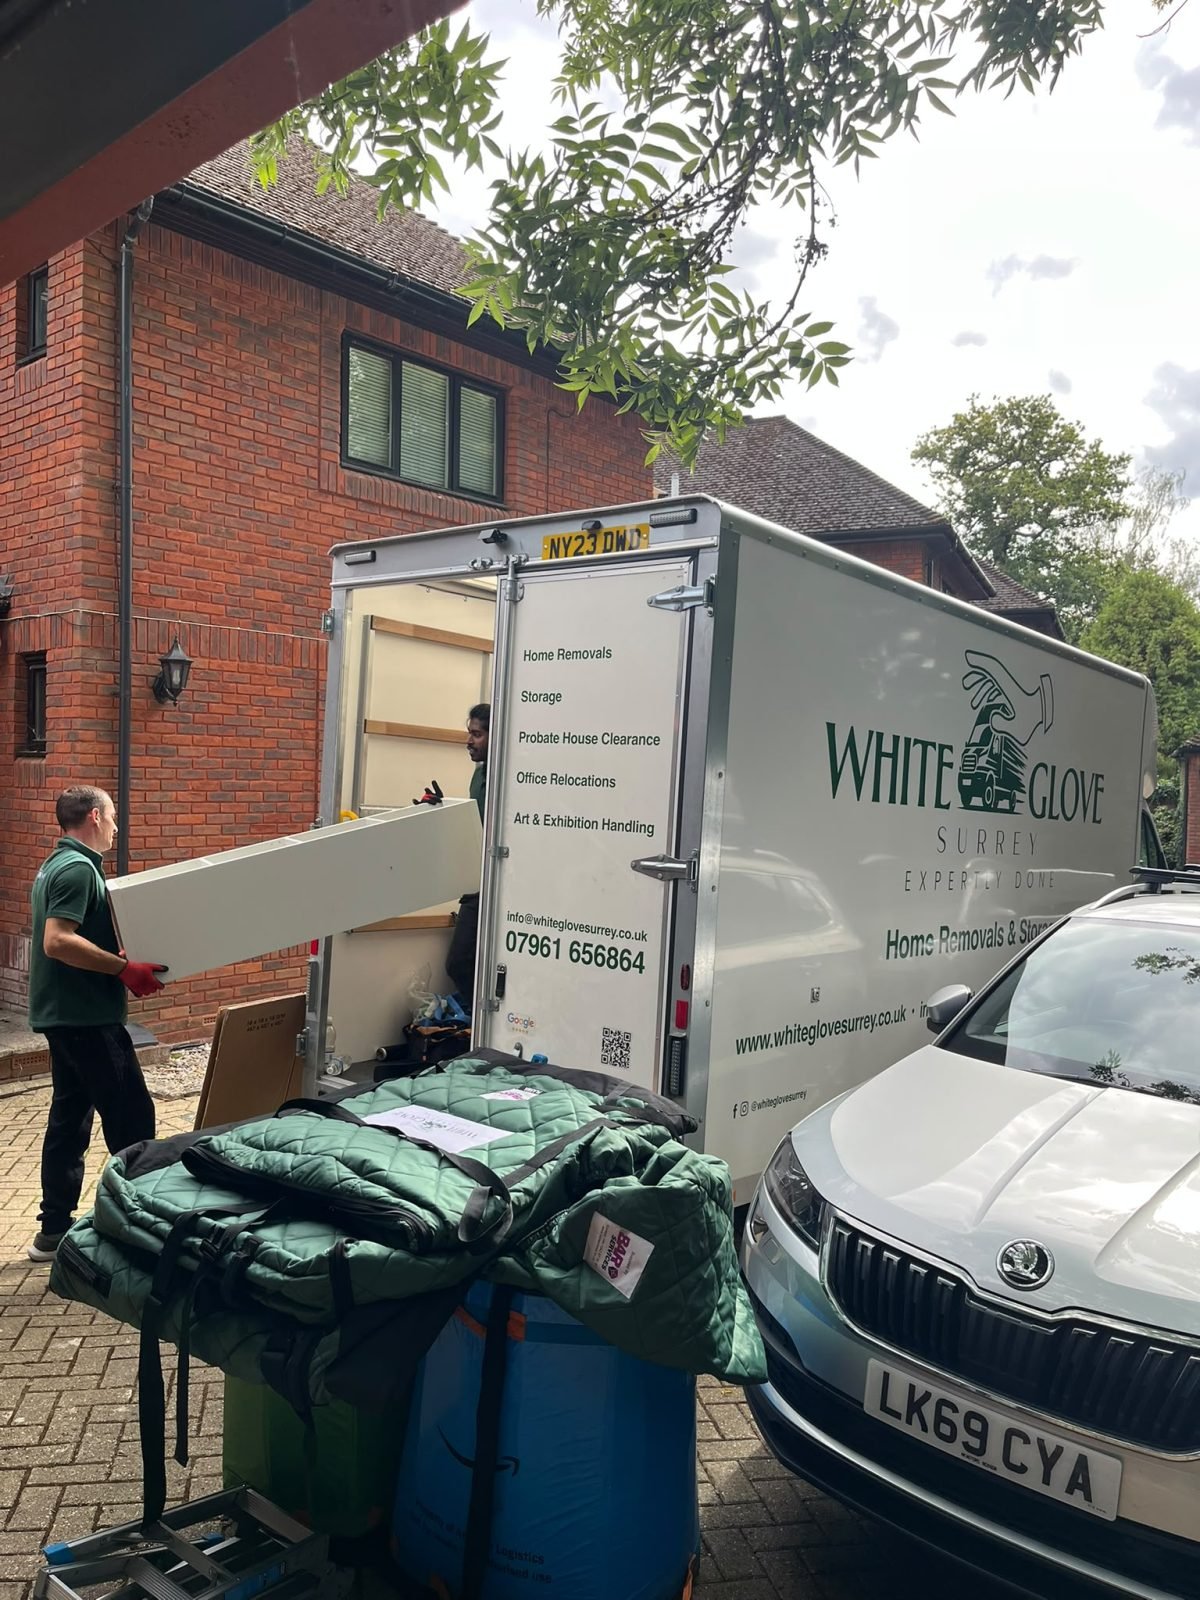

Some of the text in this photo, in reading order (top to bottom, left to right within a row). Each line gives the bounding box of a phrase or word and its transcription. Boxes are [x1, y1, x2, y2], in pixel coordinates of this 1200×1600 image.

[550, 528, 641, 559] NY23 DWD
[523, 647, 612, 662] Home Removals
[521, 690, 562, 705] Storage
[518, 731, 660, 746] Probate House Clearance
[516, 771, 616, 788] Office Relocations
[826, 721, 1104, 824] WHITE GLOVE
[513, 812, 655, 837] Art & Exhibition Handling
[937, 826, 1039, 856] SURREY
[905, 870, 1055, 891] EXPERTLY DONE
[507, 911, 647, 942] info@whiteglovesurrey.co.uk
[886, 929, 934, 960] Home
[938, 921, 1004, 954] Removals
[1007, 920, 1016, 946] &
[505, 930, 646, 974] 07961 656864
[507, 1012, 535, 1028] Google
[735, 1005, 906, 1055] www.whiteglovesurrey.co.uk
[751, 1089, 807, 1112] @whiteglovesurrey
[602, 1234, 617, 1270] SERVICES
[611, 1231, 630, 1268] BAR
[879, 1371, 1093, 1503] LK69 CYA
